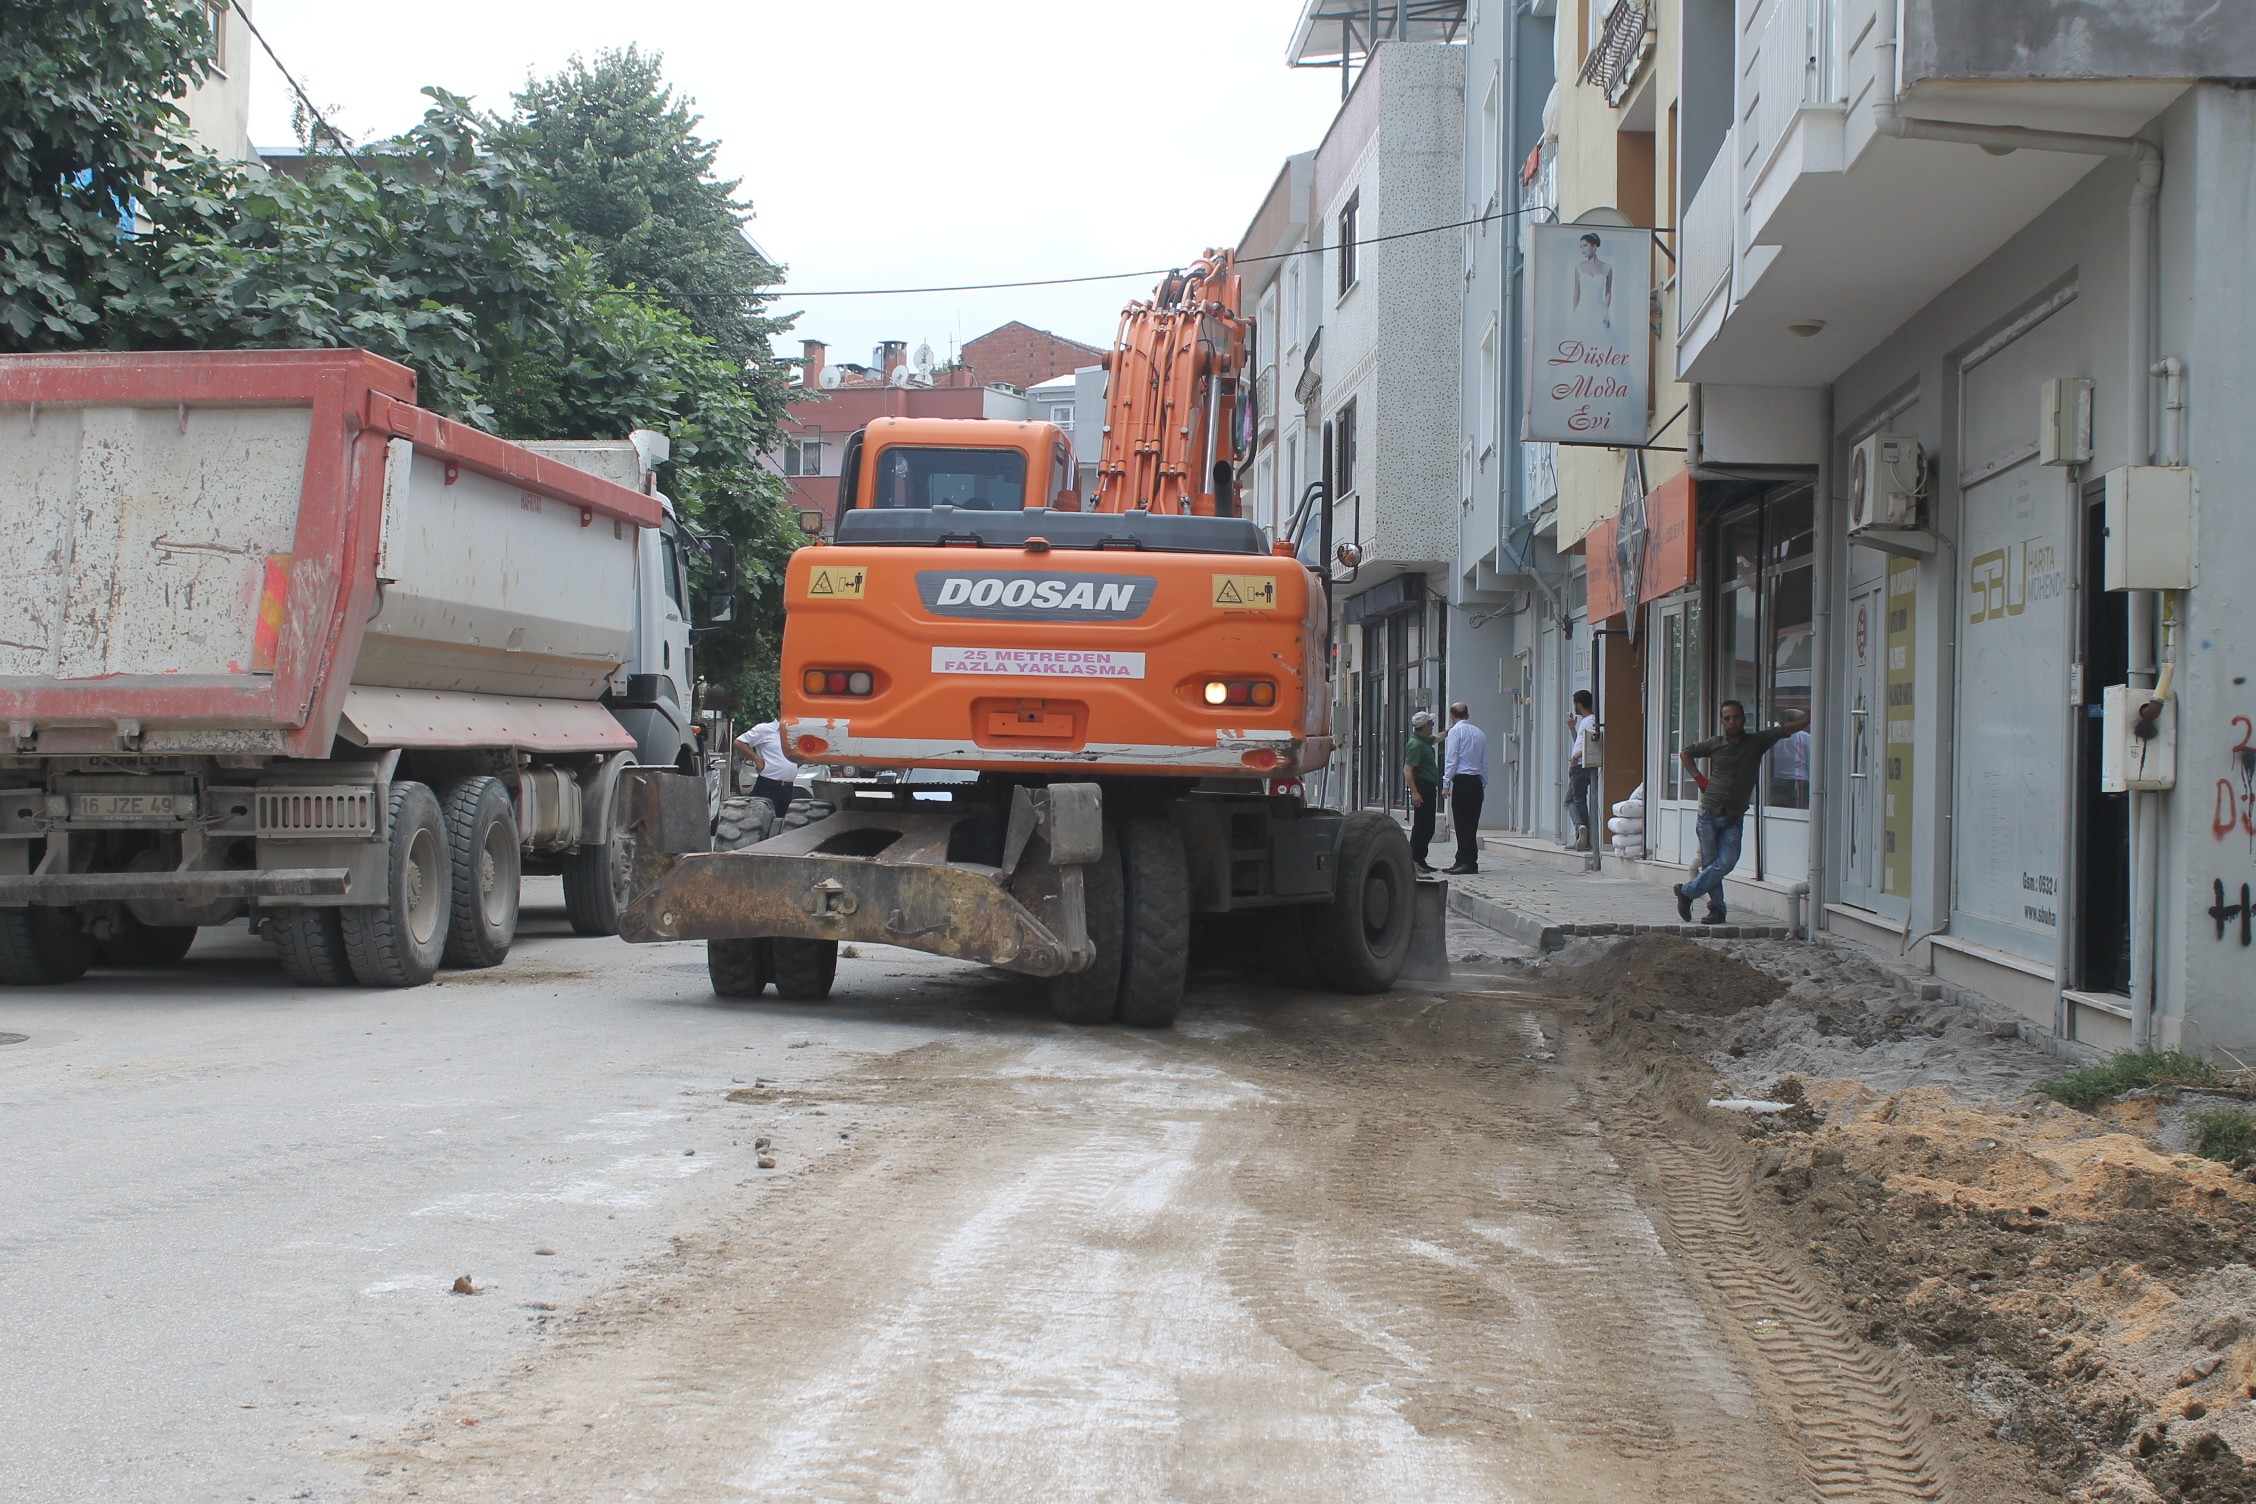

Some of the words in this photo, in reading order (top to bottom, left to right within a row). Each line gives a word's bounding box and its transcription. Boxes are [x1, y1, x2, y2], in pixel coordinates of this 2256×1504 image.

[1547, 340, 1630, 367] Düşler
[1551, 375, 1629, 400] Moda
[1567, 404, 1611, 431] Evi
[936, 578, 1136, 612] DOOSAN
[963, 650, 988, 660] 25
[995, 651, 1111, 663] METREDEN
[944, 661, 1008, 672] FAZLA
[1016, 663, 1131, 677] YAKLAŞMA
[82, 798, 99, 815] 16
[106, 797, 144, 814] JZE
[151, 797, 172, 814] 49
[2038, 875, 2053, 895] 0532
